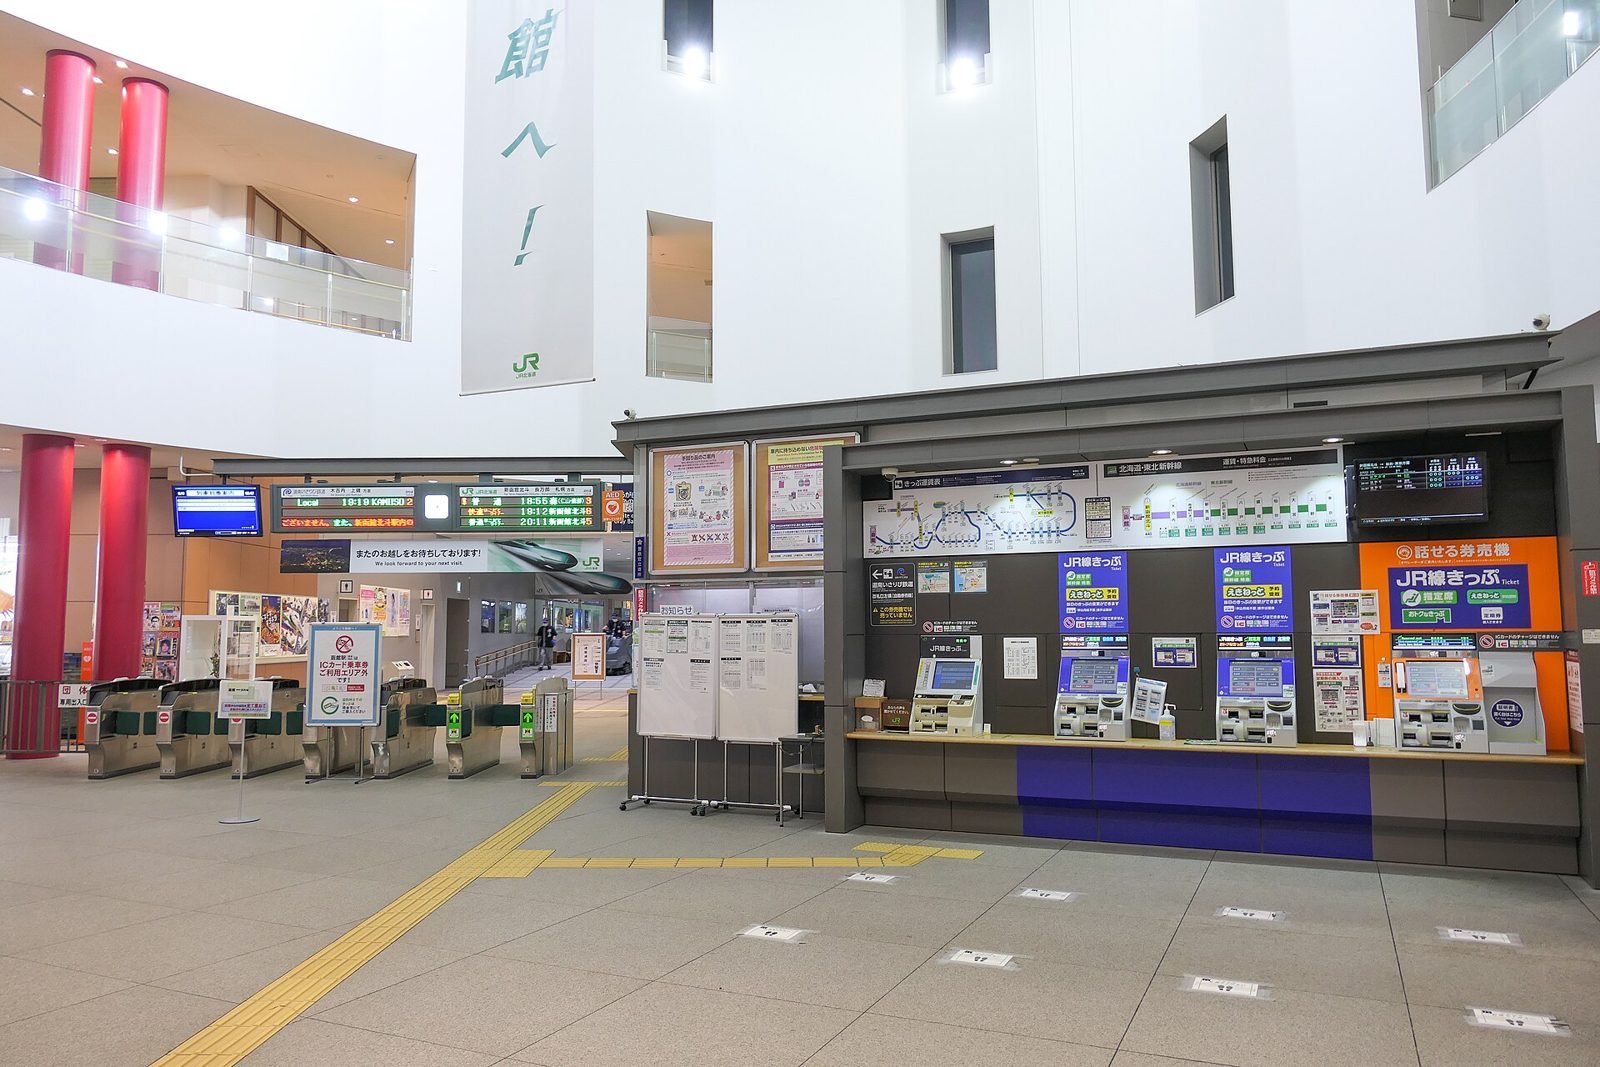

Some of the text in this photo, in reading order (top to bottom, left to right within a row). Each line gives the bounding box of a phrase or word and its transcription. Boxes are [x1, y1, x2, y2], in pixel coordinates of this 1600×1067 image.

[513, 353, 539, 372] JR
[356, 550, 481, 558] またのお越しをお待ちしております!
[1415, 543, 1510, 558] 話せる券売機
[583, 557, 600, 566] JR
[1220, 551, 1285, 563] JR線きっぷ
[1064, 556, 1122, 568] JR線きっぷ
[1396, 569, 1500, 587] JR線きっぷ
[1069, 590, 1104, 599] えきねっと
[1226, 587, 1265, 597] えきねっと
[1424, 592, 1453, 600] 指定席
[661, 607, 692, 615] お知らせ
[63, 686, 88, 694] 団体
